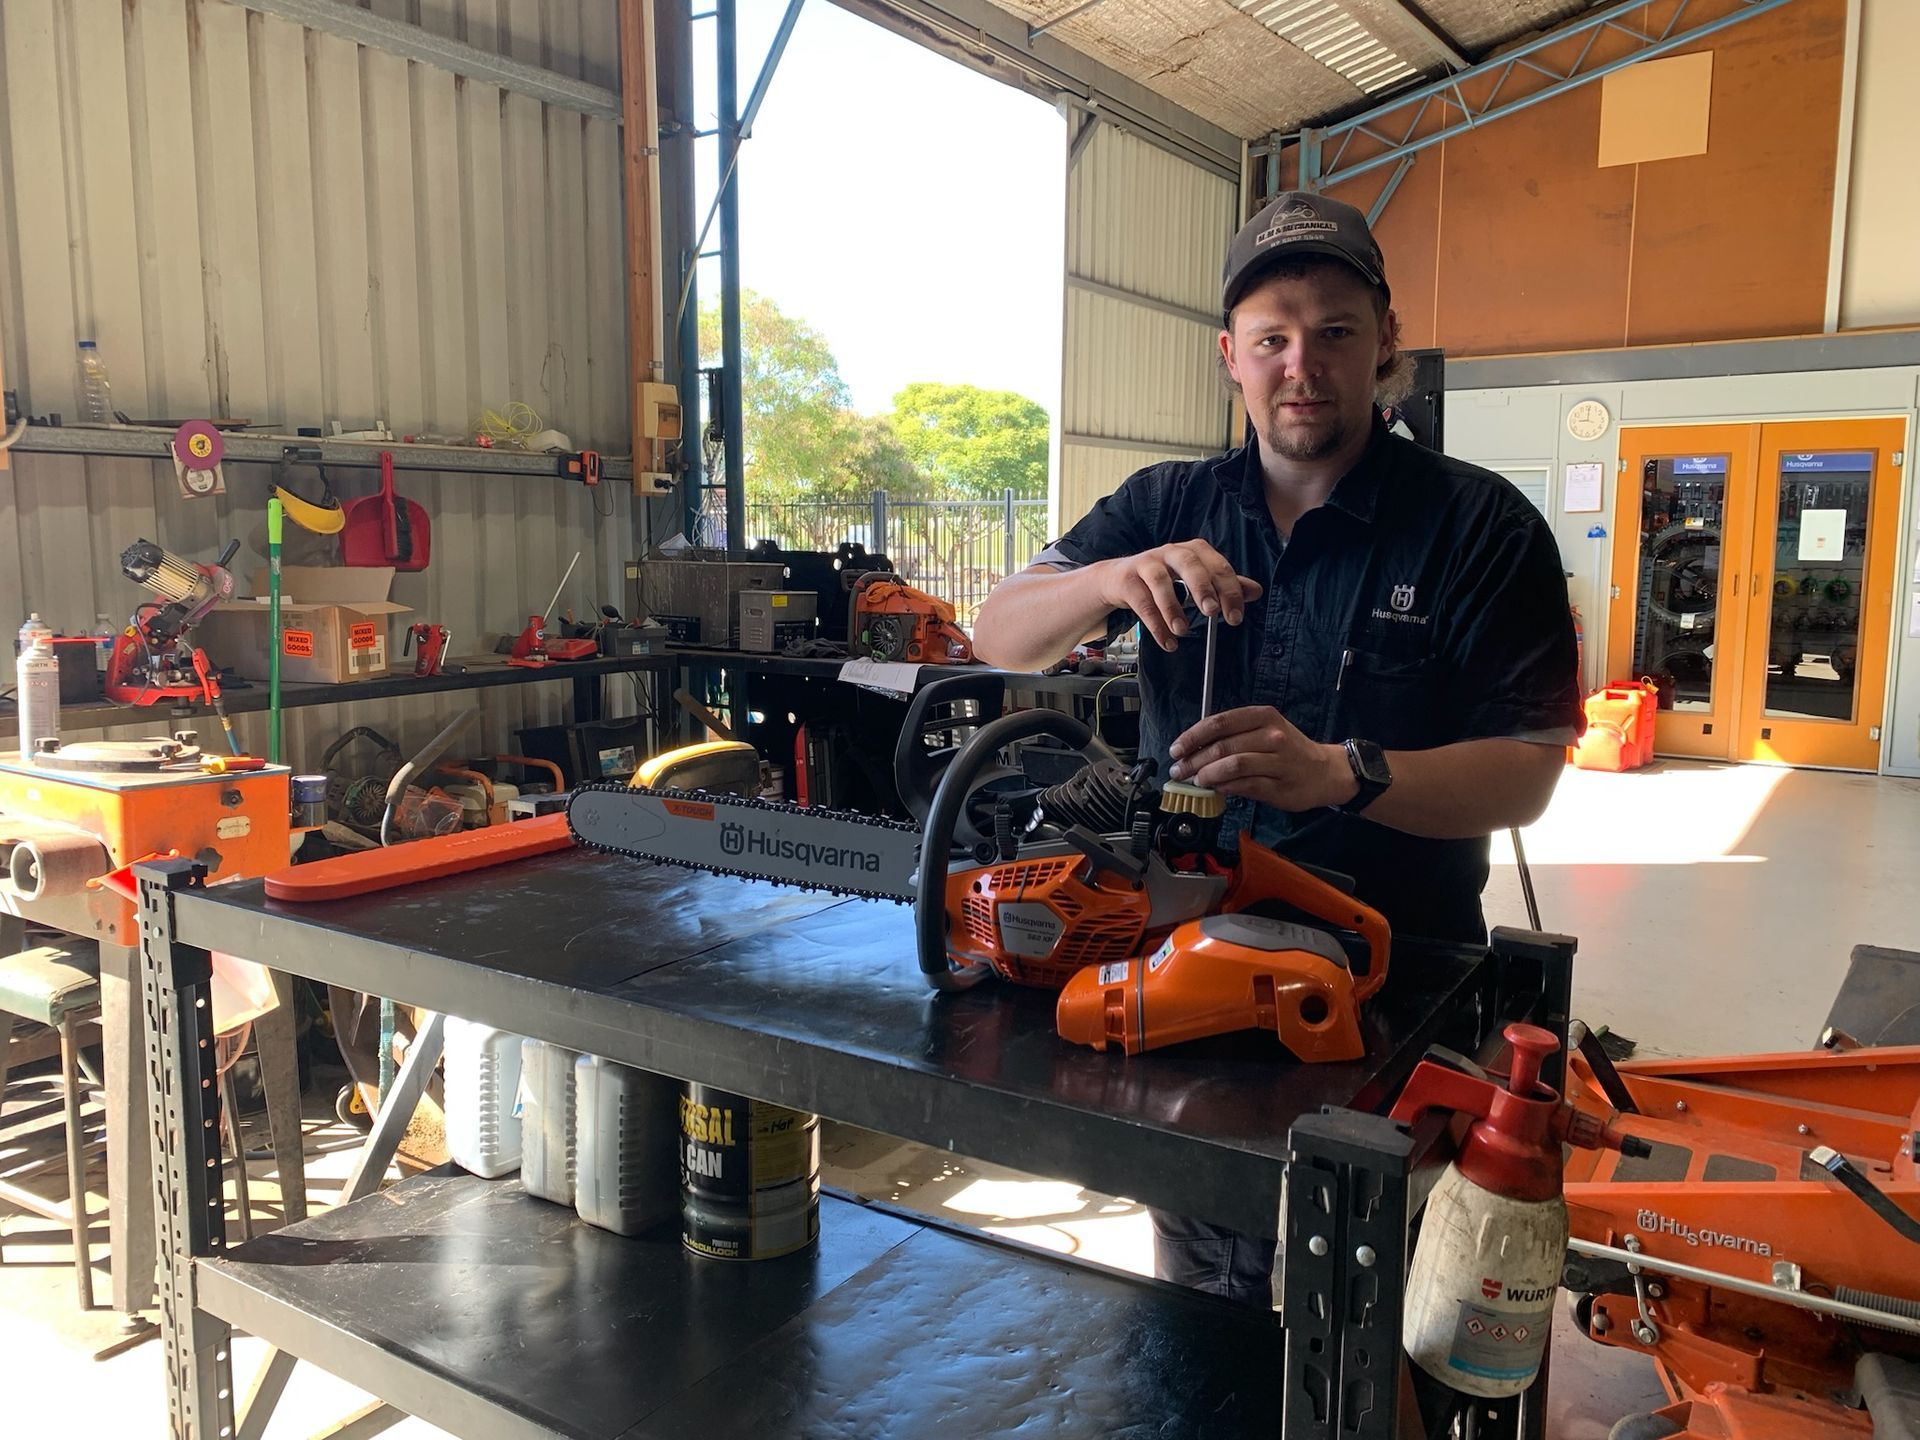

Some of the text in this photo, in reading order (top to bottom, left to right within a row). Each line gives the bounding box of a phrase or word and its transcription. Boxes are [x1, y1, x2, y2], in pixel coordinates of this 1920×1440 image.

[1682, 462, 1717, 471] Husqvarna
[1786, 461, 1824, 470] Husqvarna
[1371, 608, 1427, 625] Husqvarna
[354, 627, 372, 635] MIXED
[288, 635, 309, 644] MIXED
[353, 635, 373, 644] GOODS
[287, 644, 310, 652] GOODS
[747, 829, 880, 873] Husqvarna
[1012, 912, 1056, 929] Husqvarna
[686, 1143, 722, 1179] CAN
[1660, 1215, 1772, 1257] Husqvarna
[689, 1238, 739, 1257] McCULLOCH
